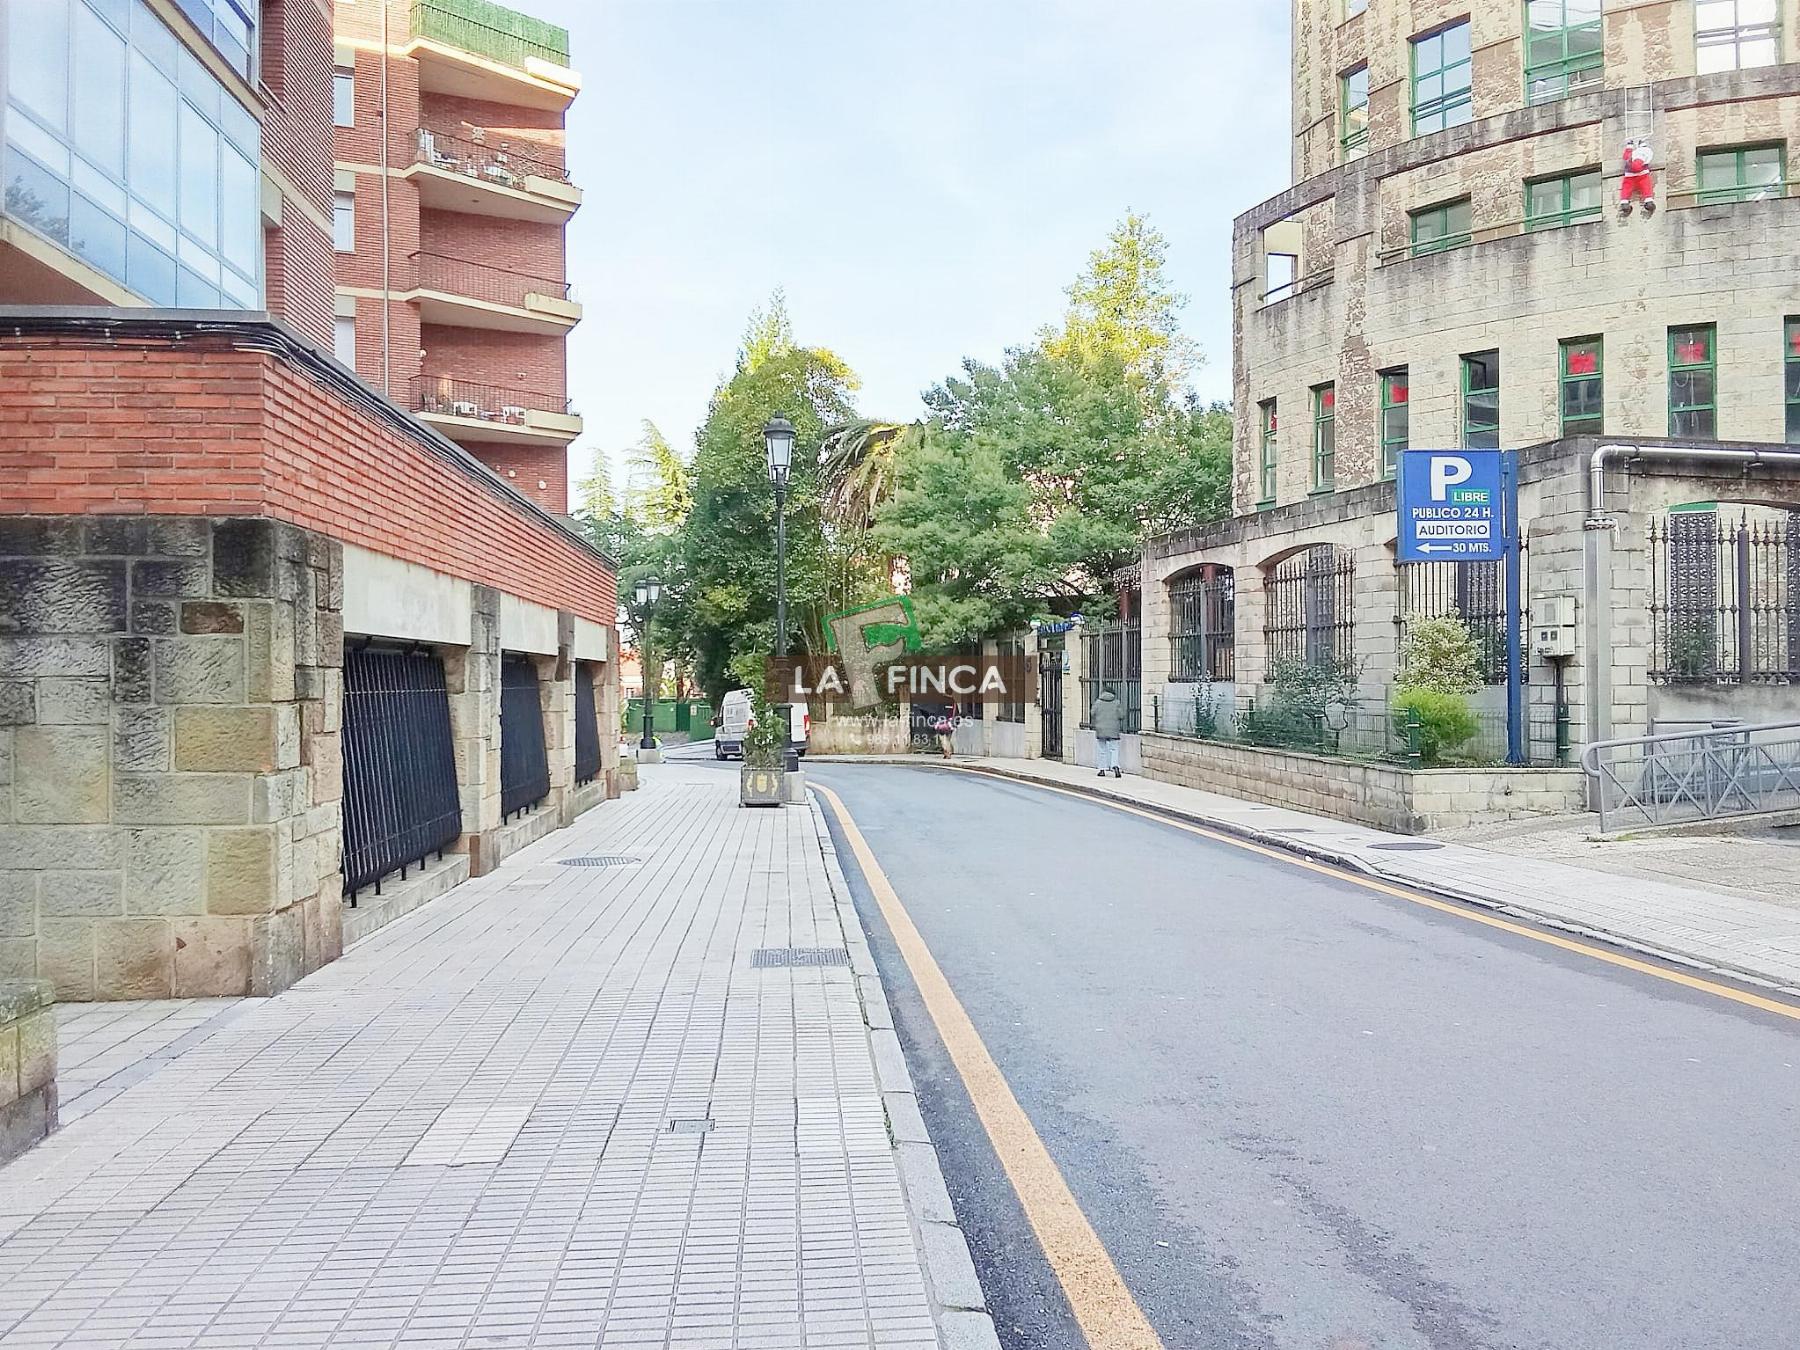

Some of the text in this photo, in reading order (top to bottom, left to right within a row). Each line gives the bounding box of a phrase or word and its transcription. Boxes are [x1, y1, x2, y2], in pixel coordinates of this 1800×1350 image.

[1431, 456, 1472, 501] P
[1453, 491, 1488, 502] LIBRE
[1412, 507, 1495, 519] PUBLICO 24 H.
[1419, 525, 1488, 535] AUDITORIO
[1452, 542, 1492, 553] 30 MTS.
